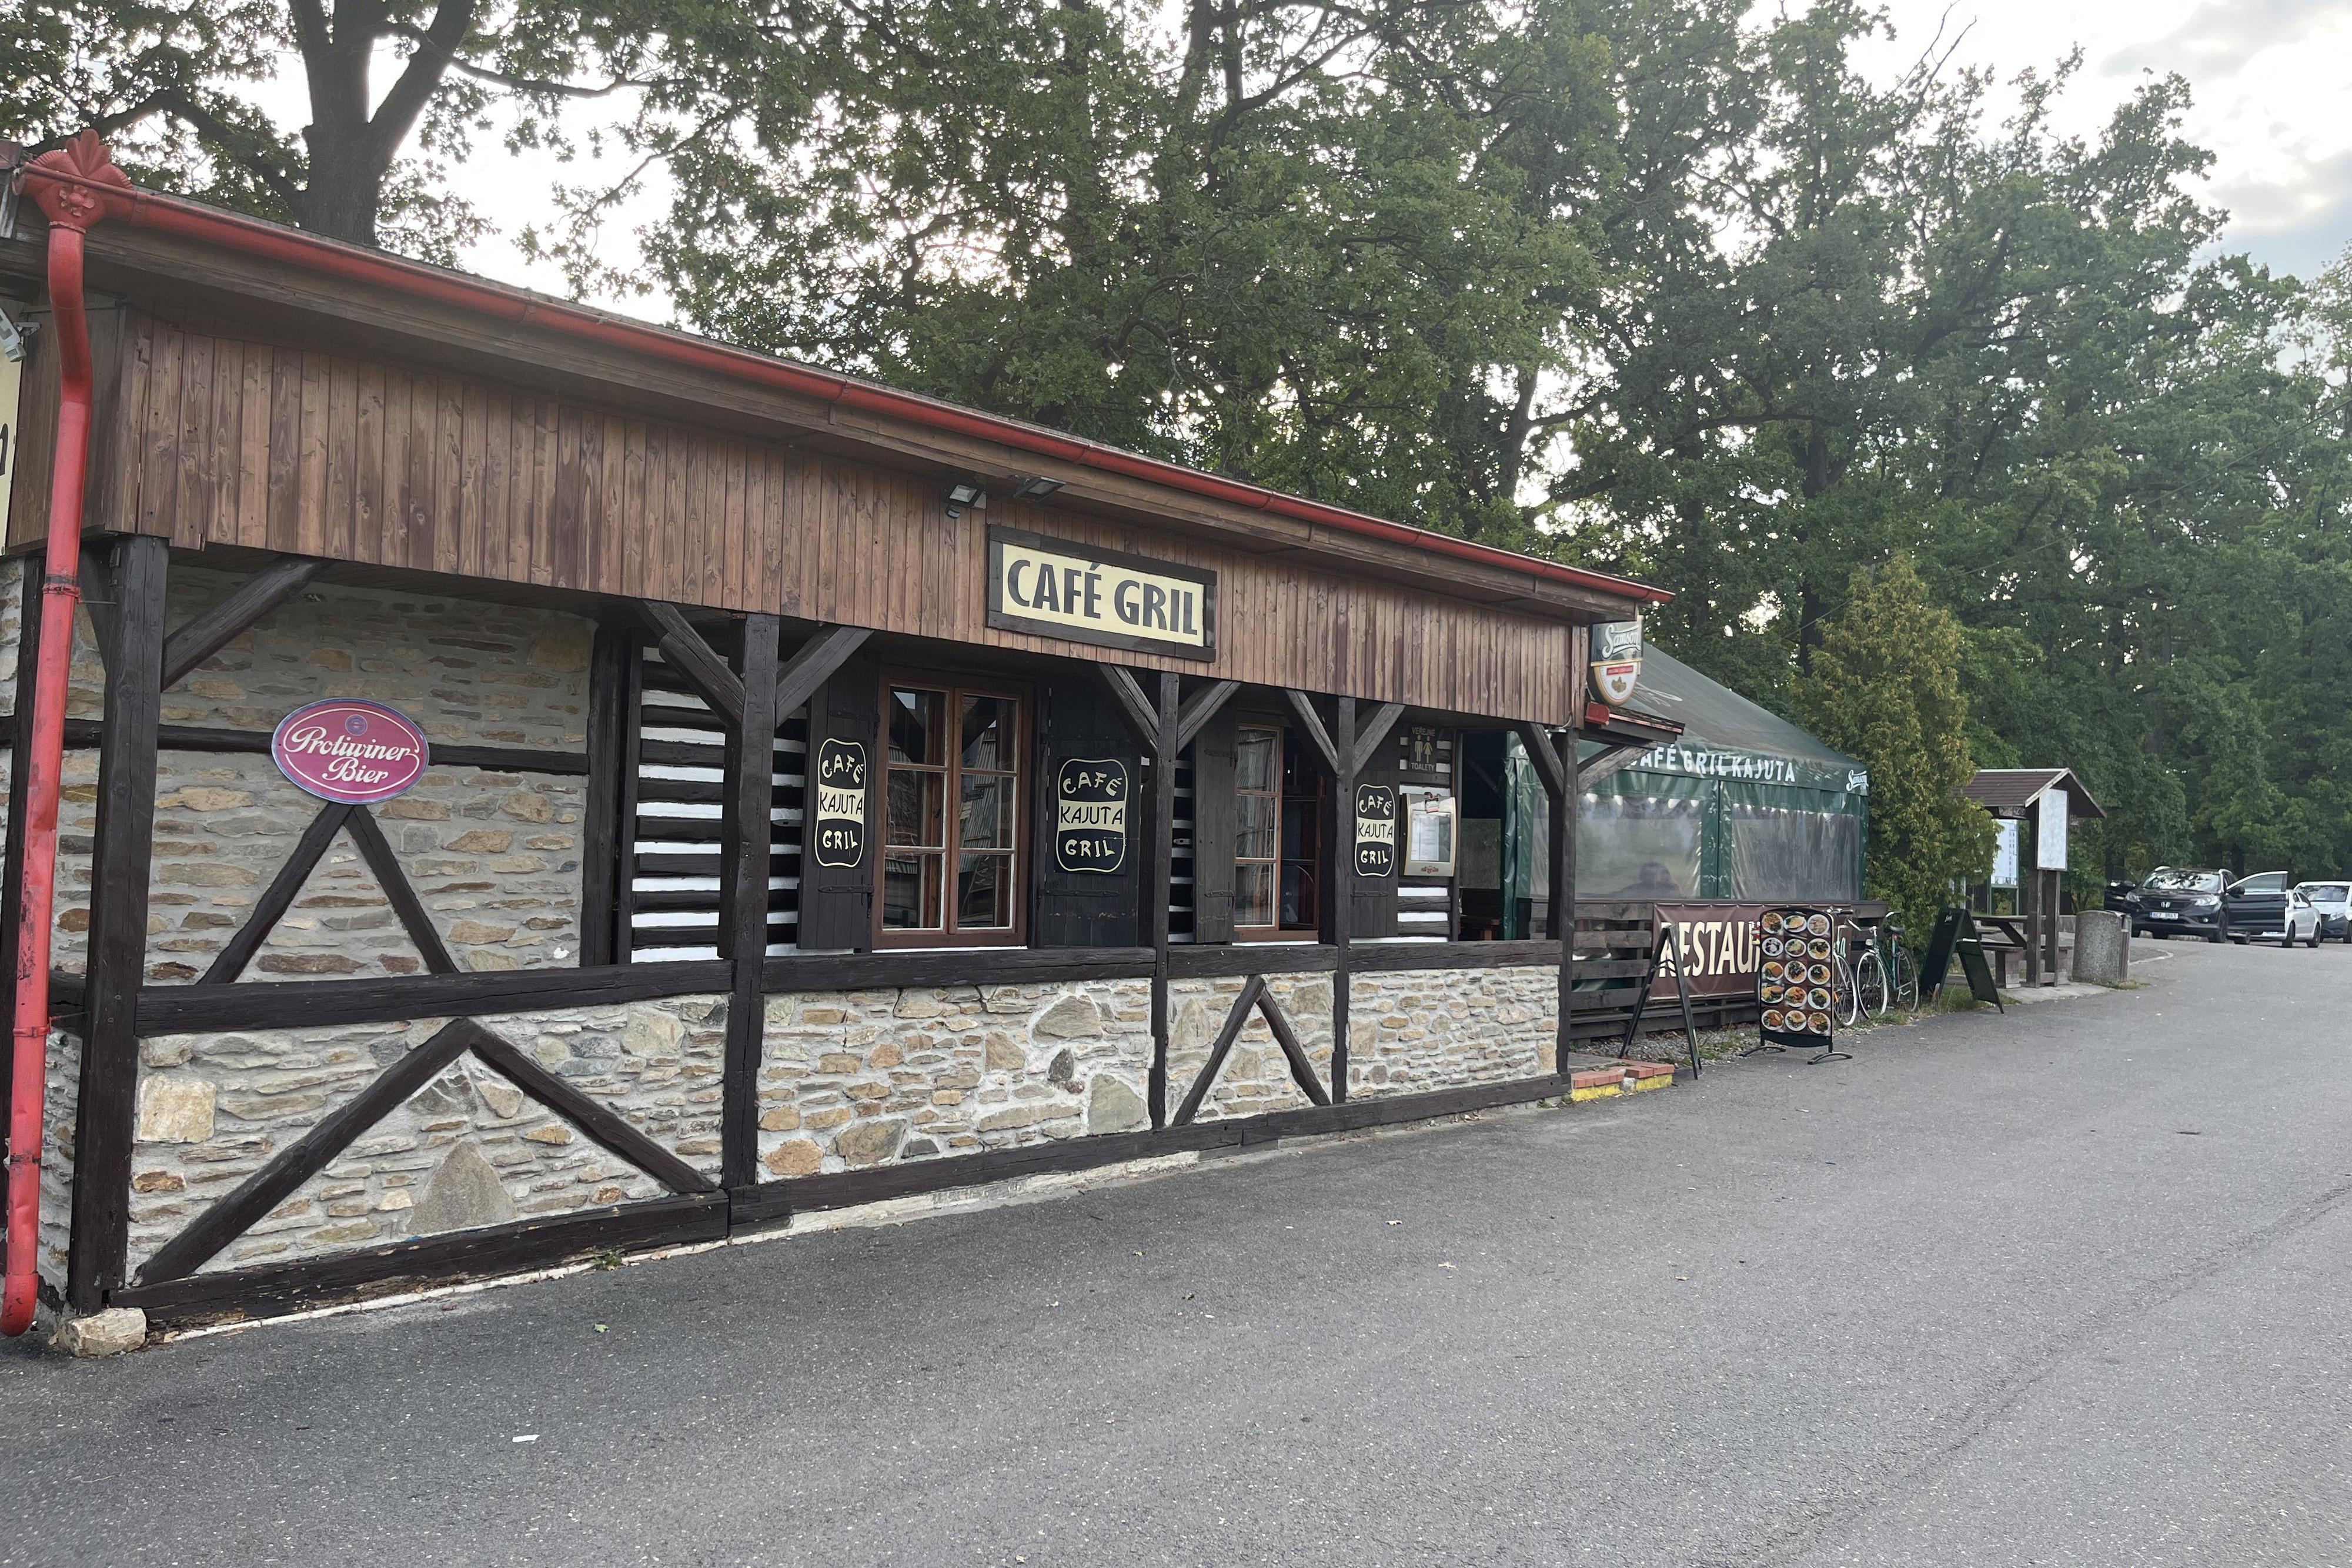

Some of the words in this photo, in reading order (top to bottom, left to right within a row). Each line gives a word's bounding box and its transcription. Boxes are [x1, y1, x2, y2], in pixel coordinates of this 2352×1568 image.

[1007, 559, 1101, 619] CAFÉ
[1114, 580, 1198, 636] GRIL
[322, 757, 389, 784] Bier
[821, 754, 864, 784] CAFÉ
[1411, 762, 1435, 772] TOALETY
[1631, 744, 1677, 771] AFÉ
[1683, 750, 1727, 777] GRIL
[1732, 756, 1796, 783] KAJUTA
[1063, 771, 1122, 797] CAFÉ
[820, 791, 863, 815] KAJUTA
[1359, 795, 1392, 816] CAFÉ
[1060, 806, 1123, 825] KAJUTA
[823, 830, 858, 850] GRIL
[1358, 823, 1393, 838] KAJUTA
[1065, 839, 1115, 858] GRIL
[1360, 850, 1389, 865] GRIL
